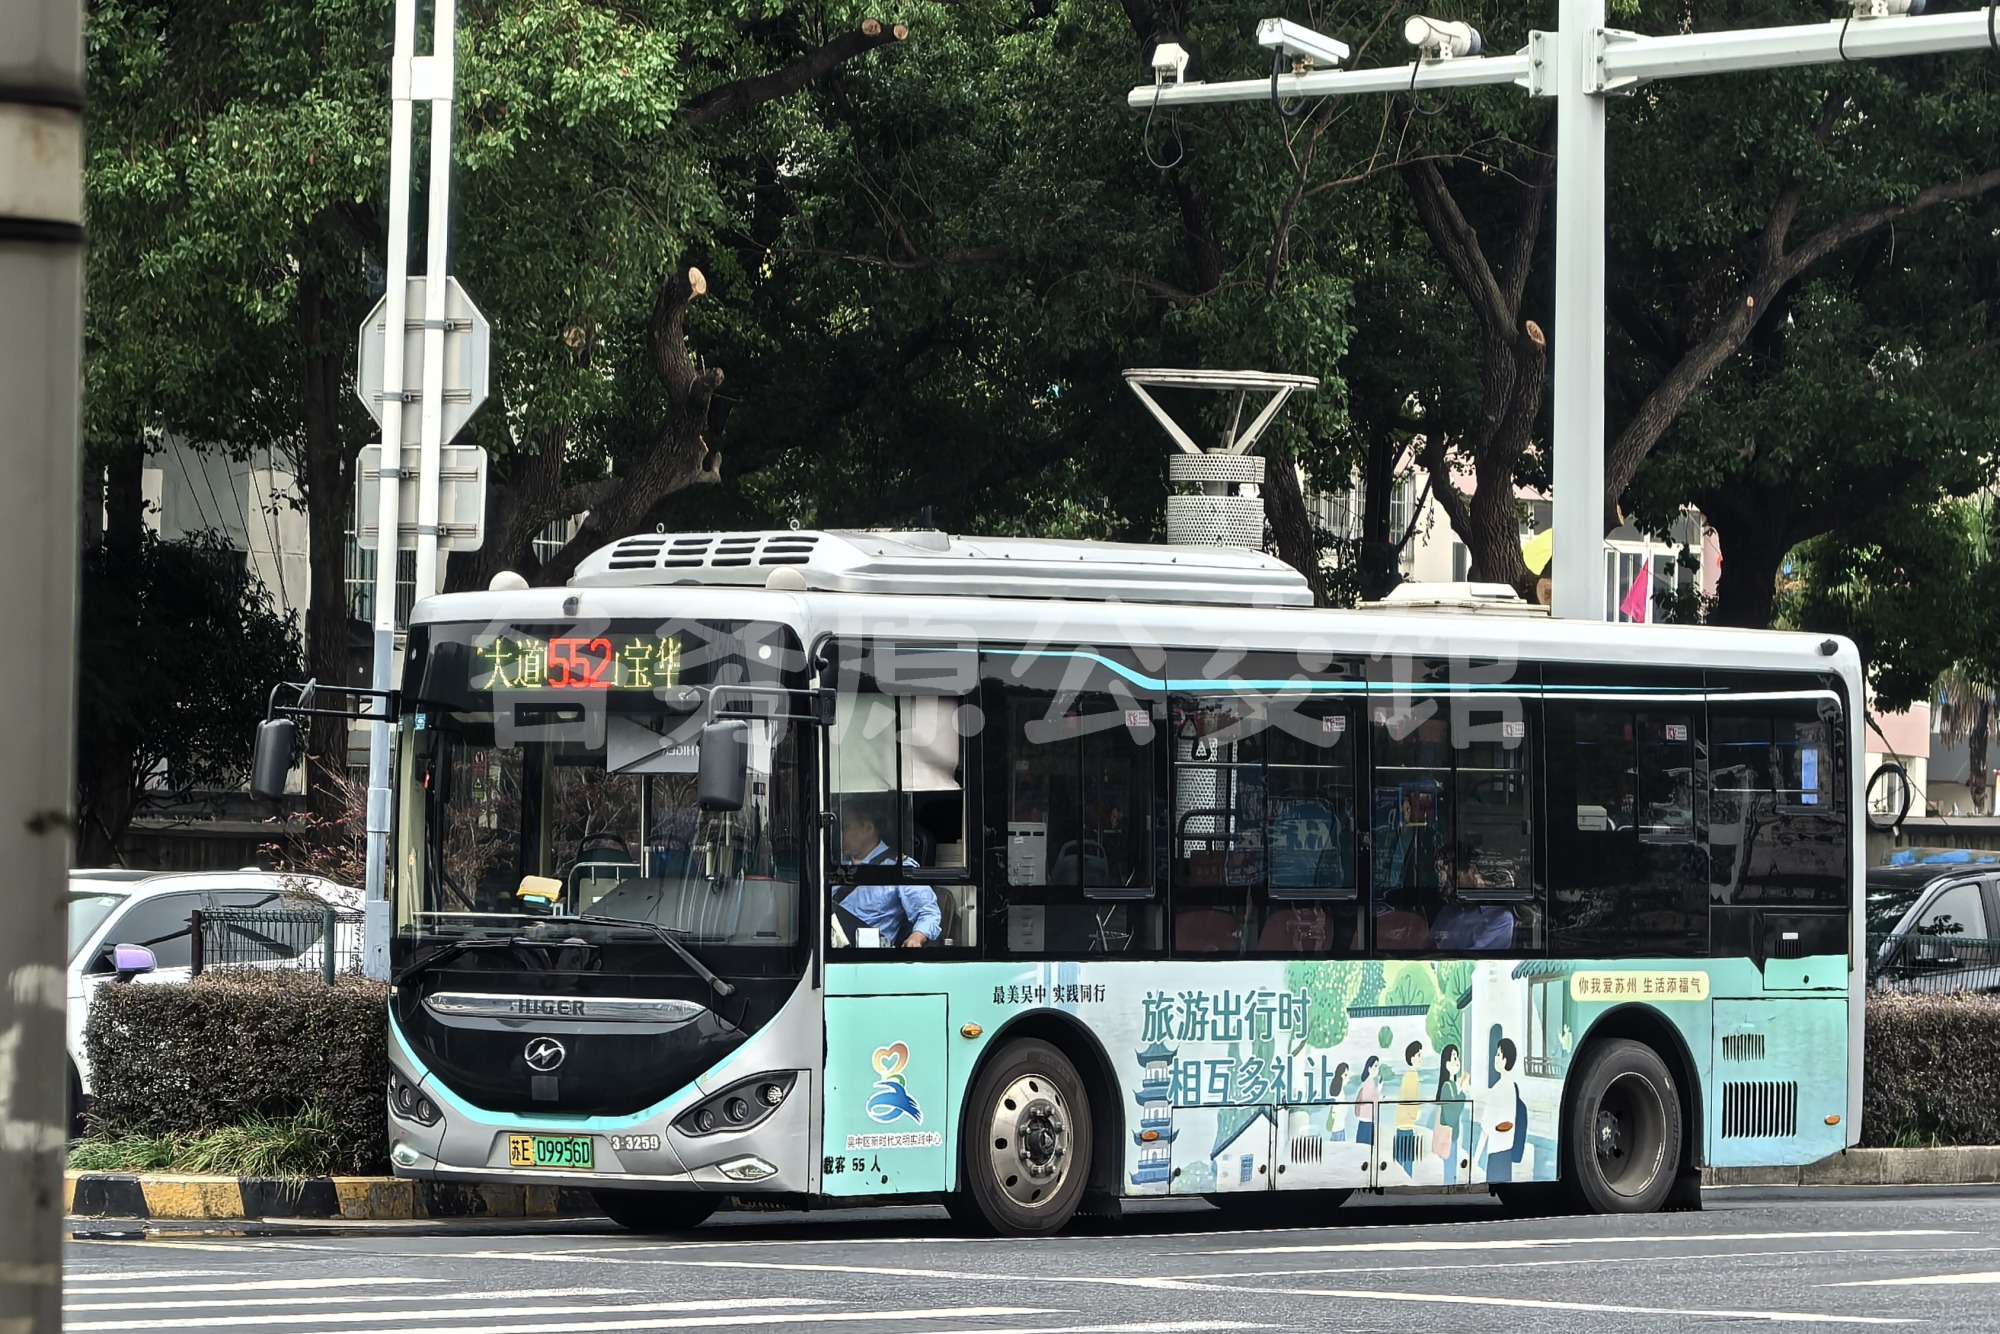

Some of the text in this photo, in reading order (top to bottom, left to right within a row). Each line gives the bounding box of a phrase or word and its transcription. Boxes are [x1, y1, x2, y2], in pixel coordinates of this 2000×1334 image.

[548, 637, 612, 690] 552
[993, 984, 1106, 1005] 最美吴中 实践同行
[1578, 977, 1701, 994] 你我爱苏州 生活添福气
[518, 998, 586, 1016] HIGER
[1141, 988, 1311, 1043] 旅游出行时
[1167, 1054, 1336, 1106] 相互多礼让
[852, 1158, 865, 1172] 55
[870, 1153, 881, 1173] 人
